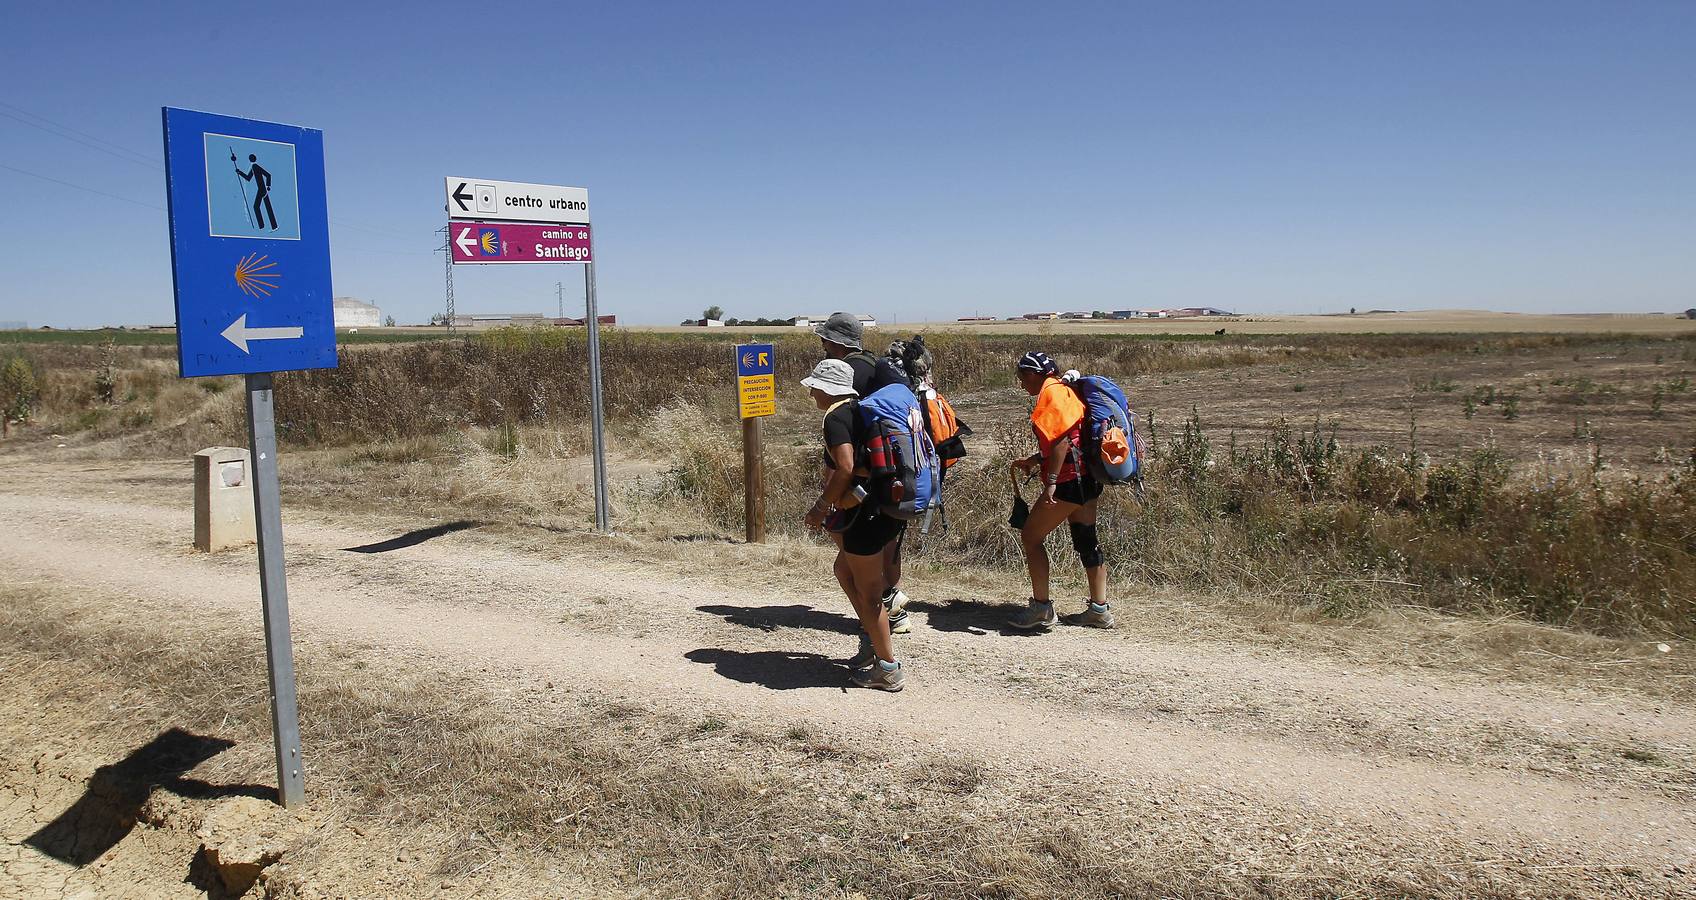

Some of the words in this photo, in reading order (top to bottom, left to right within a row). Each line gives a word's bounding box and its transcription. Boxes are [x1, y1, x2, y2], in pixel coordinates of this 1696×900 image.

[505, 195, 543, 208] centro
[549, 198, 587, 211] urbano
[542, 229, 573, 239] camino
[578, 230, 588, 240] de
[535, 243, 589, 260] Santiago
